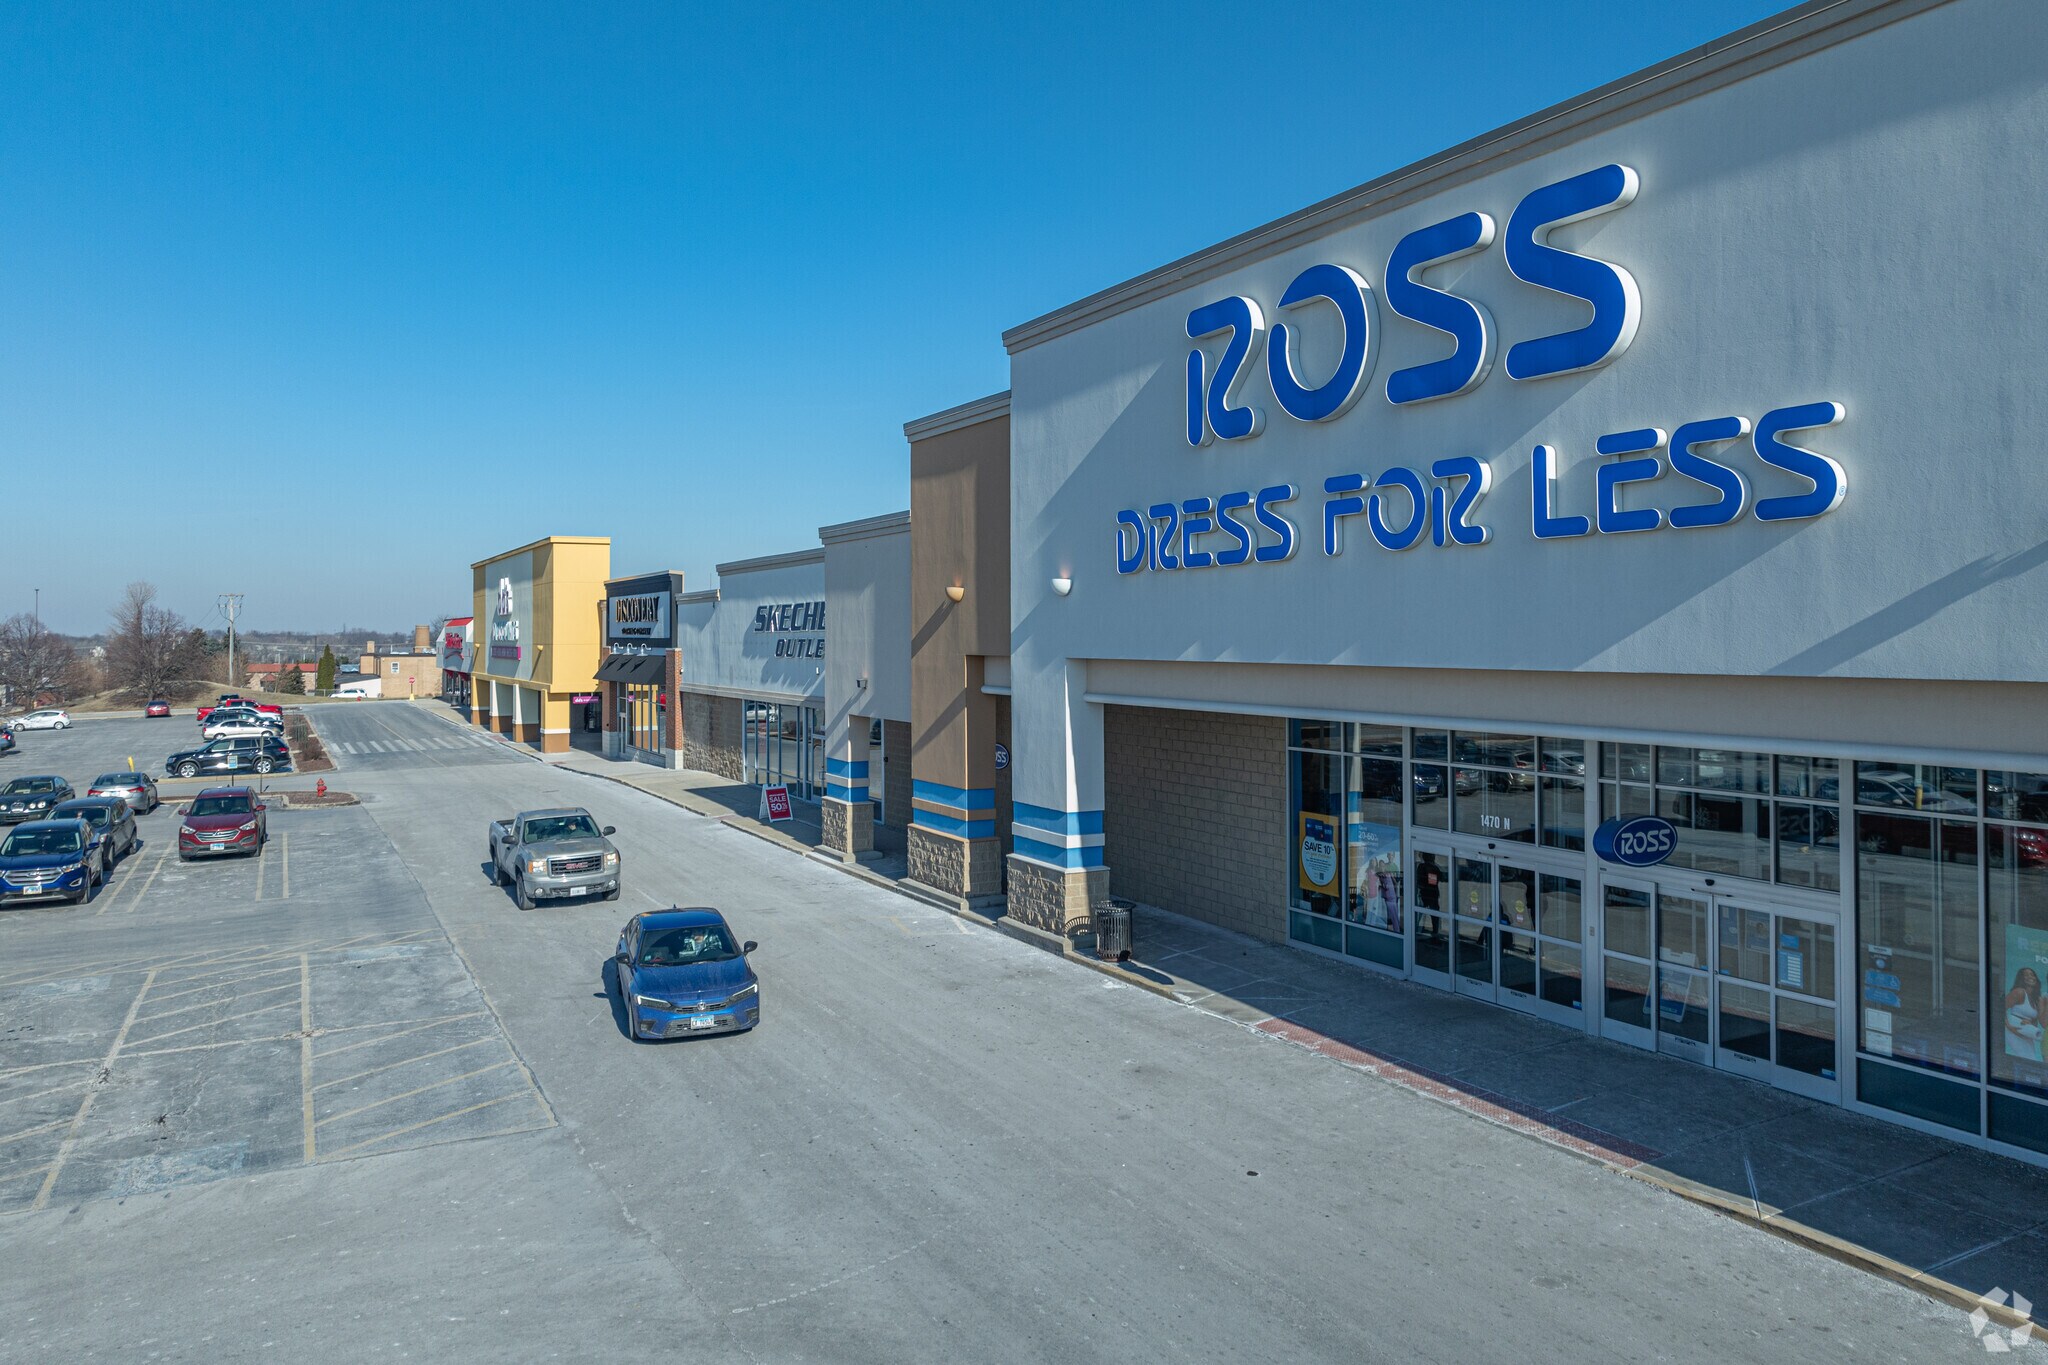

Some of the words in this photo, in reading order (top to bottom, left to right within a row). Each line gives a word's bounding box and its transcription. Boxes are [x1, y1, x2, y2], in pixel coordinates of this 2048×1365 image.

[1186, 164, 1641, 447] ROSS
[1116, 484, 1299, 574] DRESS
[1324, 456, 1492, 556] FOR
[1532, 401, 1848, 539] LESS
[616, 597, 659, 622] DISCOVERY
[769, 795, 787, 803] SALE
[1480, 814, 1500, 828] 1470
[1503, 817, 1510, 830] N
[1304, 840, 1323, 853] SAVE
[1621, 829, 1671, 855] ROSS
